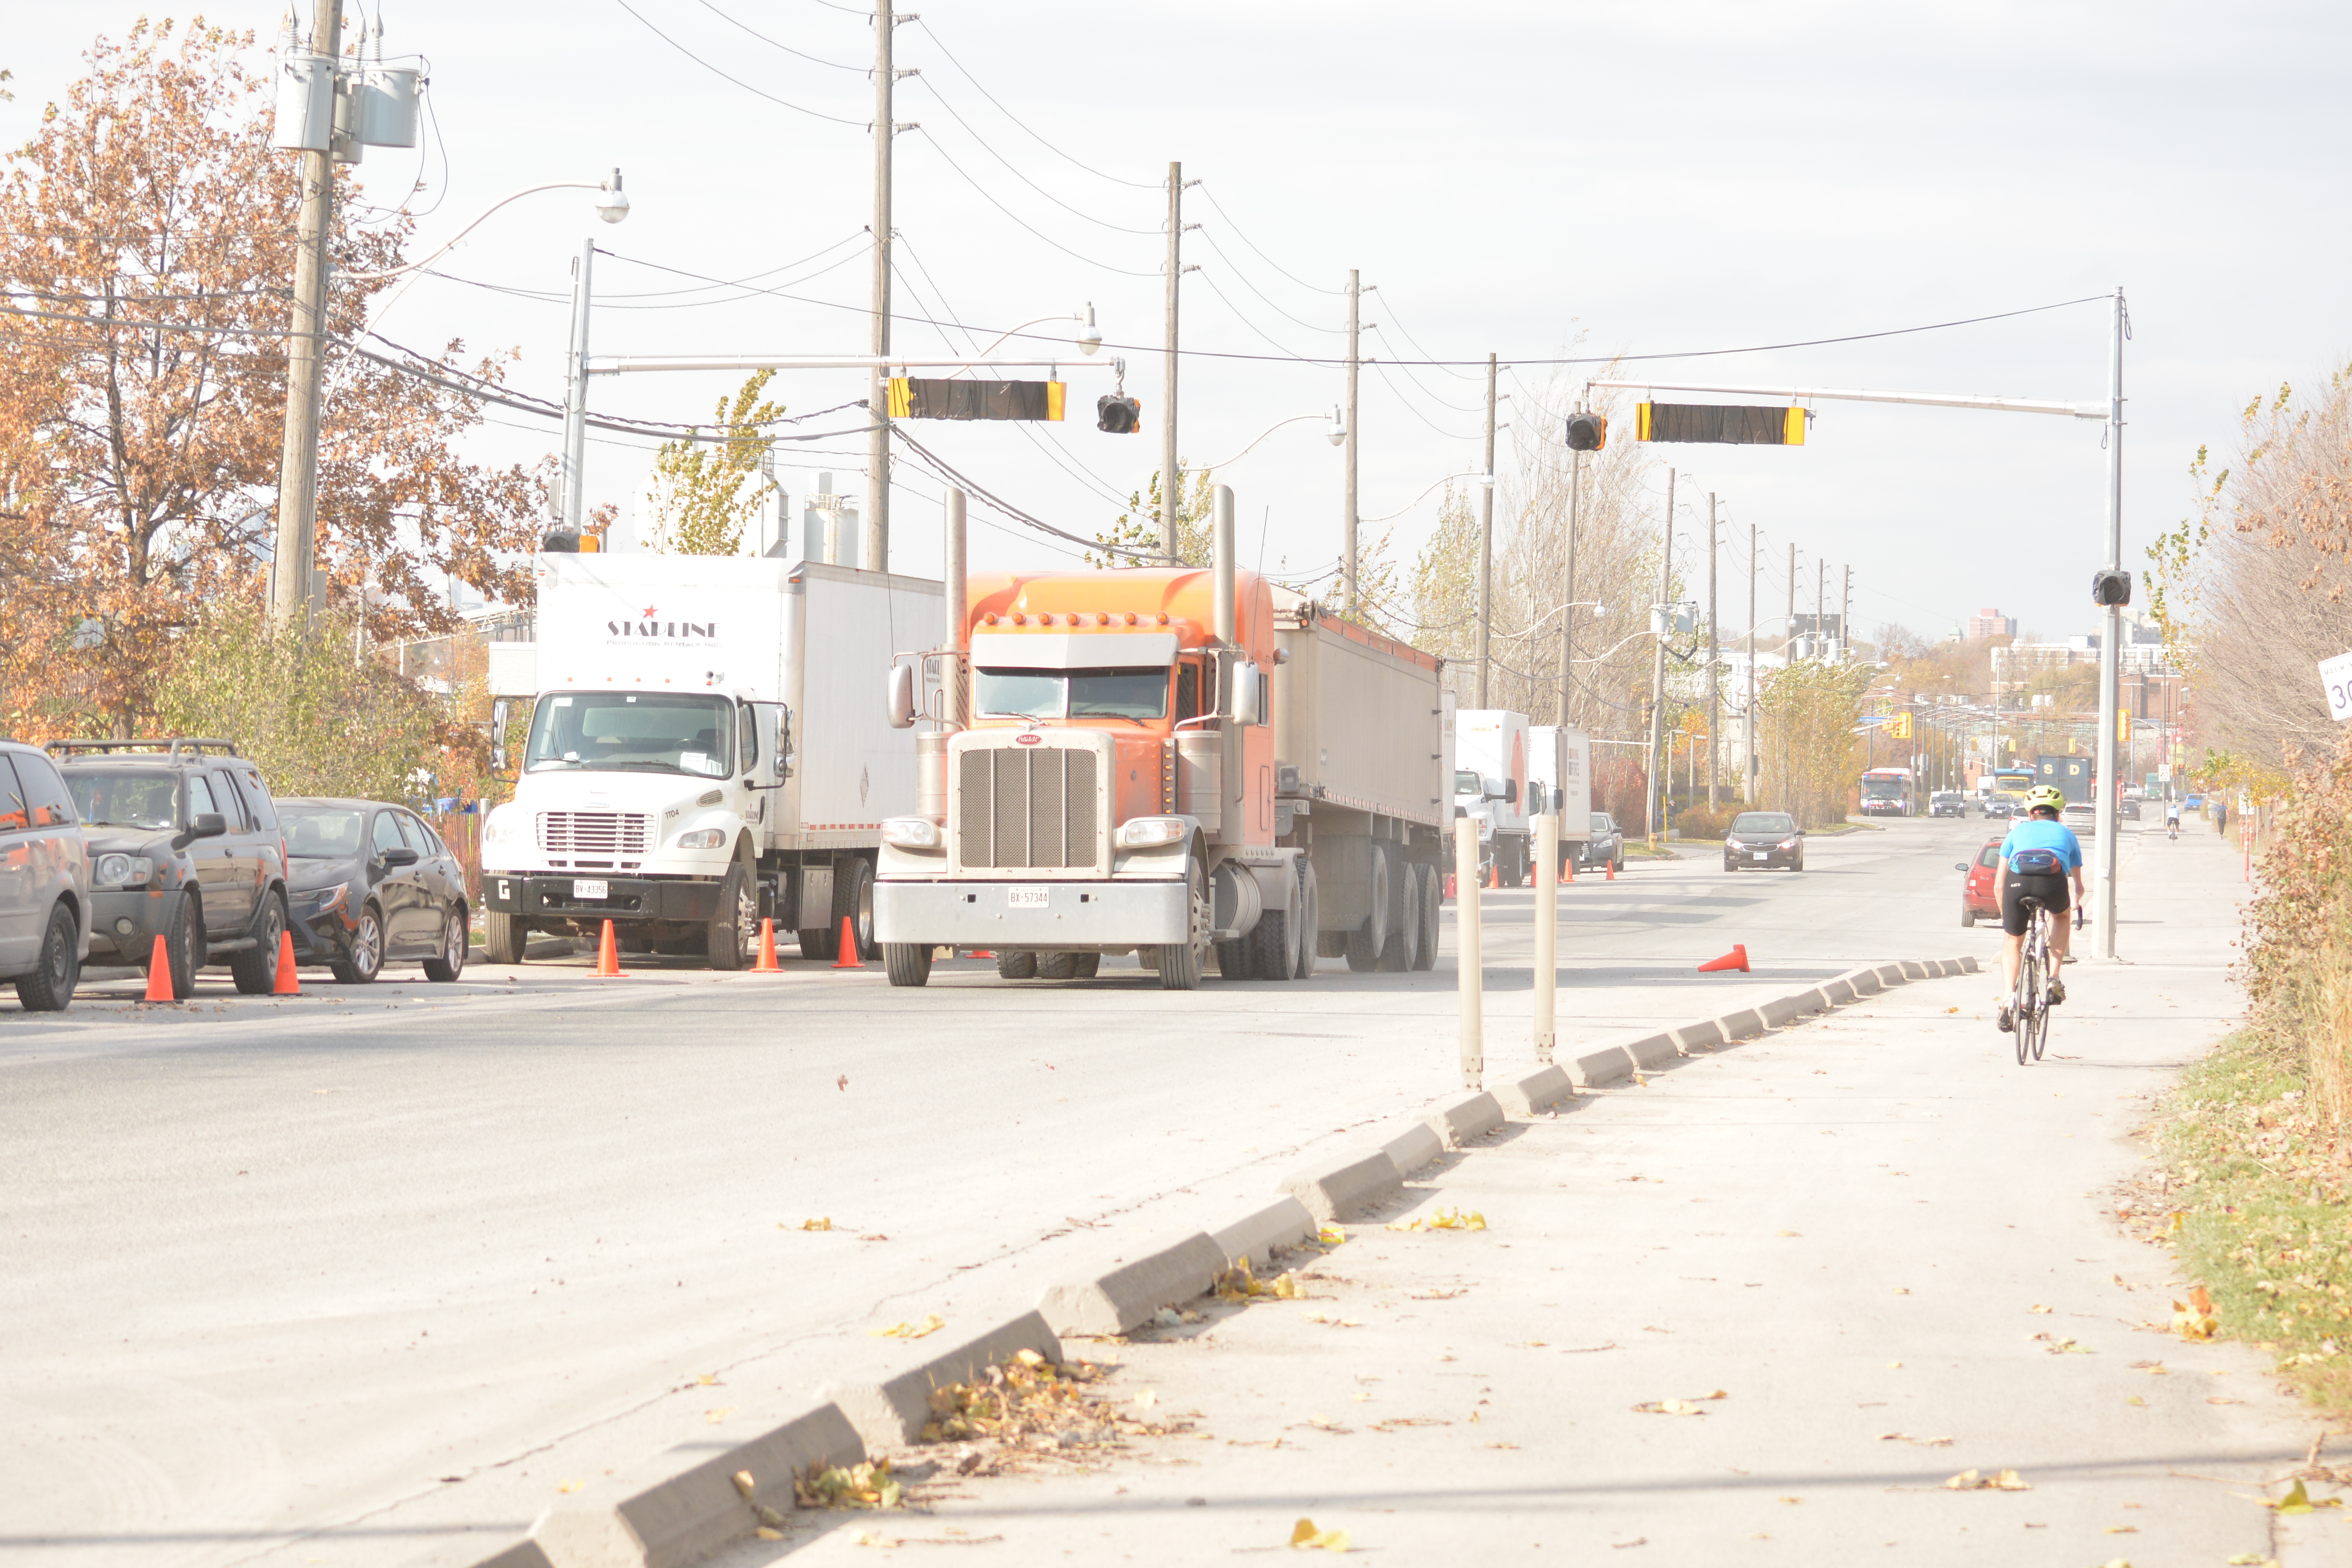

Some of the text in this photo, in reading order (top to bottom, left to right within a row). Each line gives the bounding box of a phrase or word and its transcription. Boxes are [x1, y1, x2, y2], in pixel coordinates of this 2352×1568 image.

[608, 620, 721, 638] STARLINE
[926, 659, 940, 675] STARL
[2044, 764, 2080, 775] S D
[665, 808, 679, 819] 1T04
[498, 880, 510, 900] G
[576, 884, 606, 894] BV 43356
[1011, 892, 1047, 903] BX 57344
